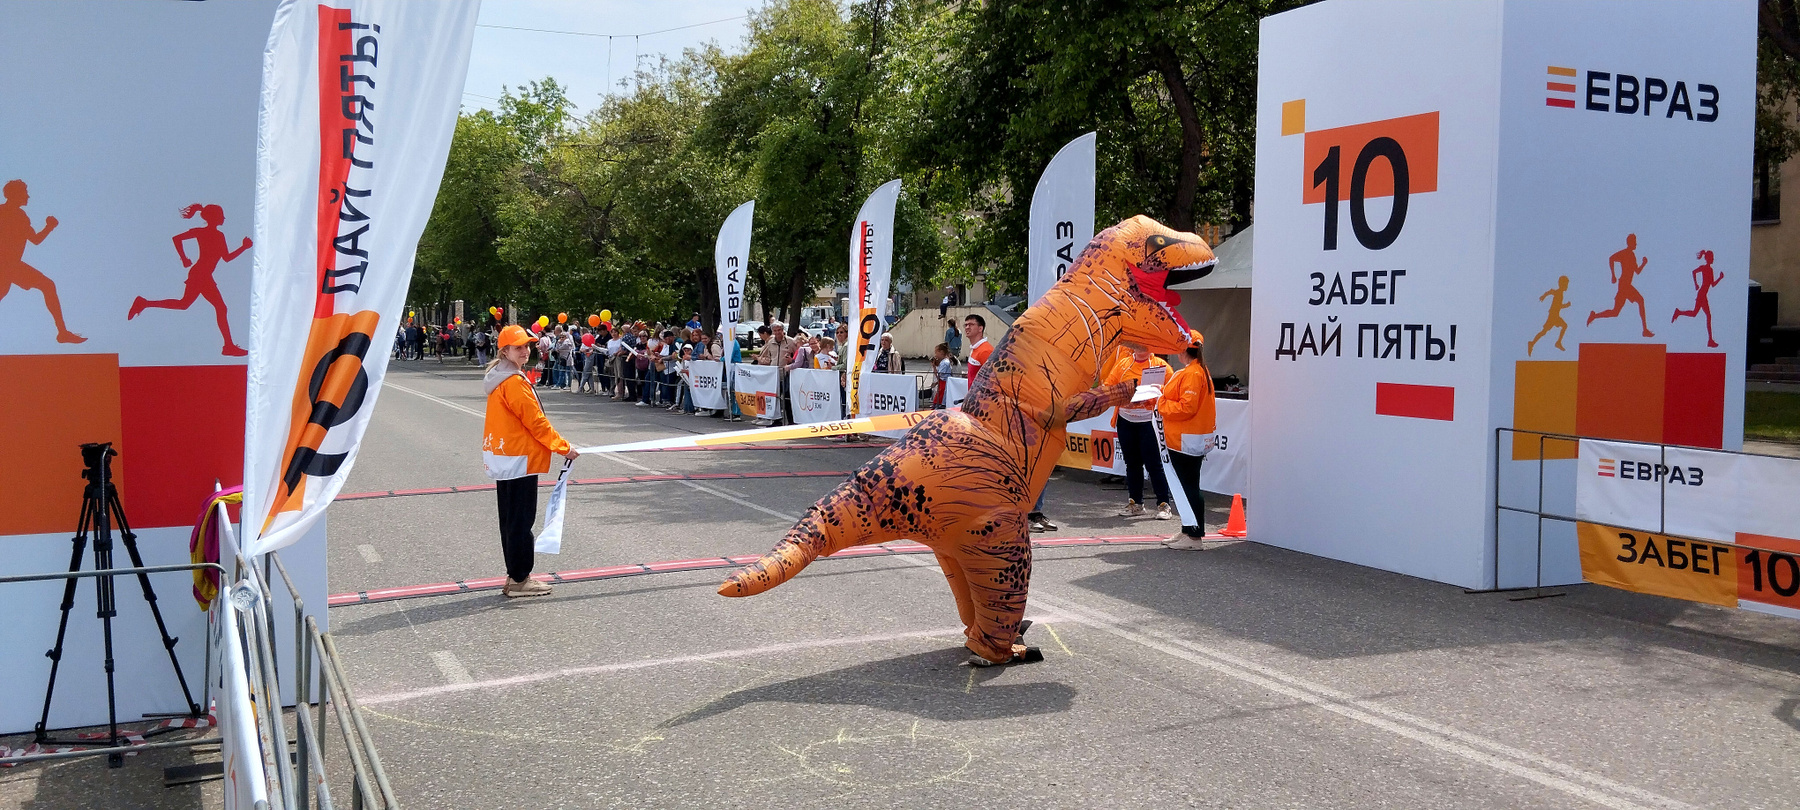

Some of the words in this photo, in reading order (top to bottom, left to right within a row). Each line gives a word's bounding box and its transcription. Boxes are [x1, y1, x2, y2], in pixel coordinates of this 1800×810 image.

[338, 22, 381, 169] ПЯТЬ!
[1586, 70, 1720, 123] ЕВРАЗ
[1313, 136, 1410, 251] 10
[321, 181, 373, 295] ДАЙ
[863, 224, 874, 267] ПЯТЬ!
[1056, 221, 1073, 282] РАЗ
[727, 256, 740, 323] ЕВРАЗ
[860, 272, 873, 304] ДАЙ
[1308, 269, 1407, 306] ЗАБЕГ
[858, 313, 880, 358] 10
[1275, 315, 1342, 361] ДАЙ
[1357, 324, 1457, 361] ПЯТЬ!
[700, 376, 718, 389] ЕВРАЗ
[813, 391, 831, 402] ЕВРАЗ
[873, 393, 906, 413] ЕВРАЗ
[808, 422, 854, 433] ЗАБЕГ
[1065, 436, 1090, 454] АБЕГ
[1093, 438, 1112, 462] 10
[1620, 460, 1704, 487] ЕВРАЗ
[1616, 532, 1729, 576] ЗАБЕГ
[1744, 550, 1800, 597] 10
